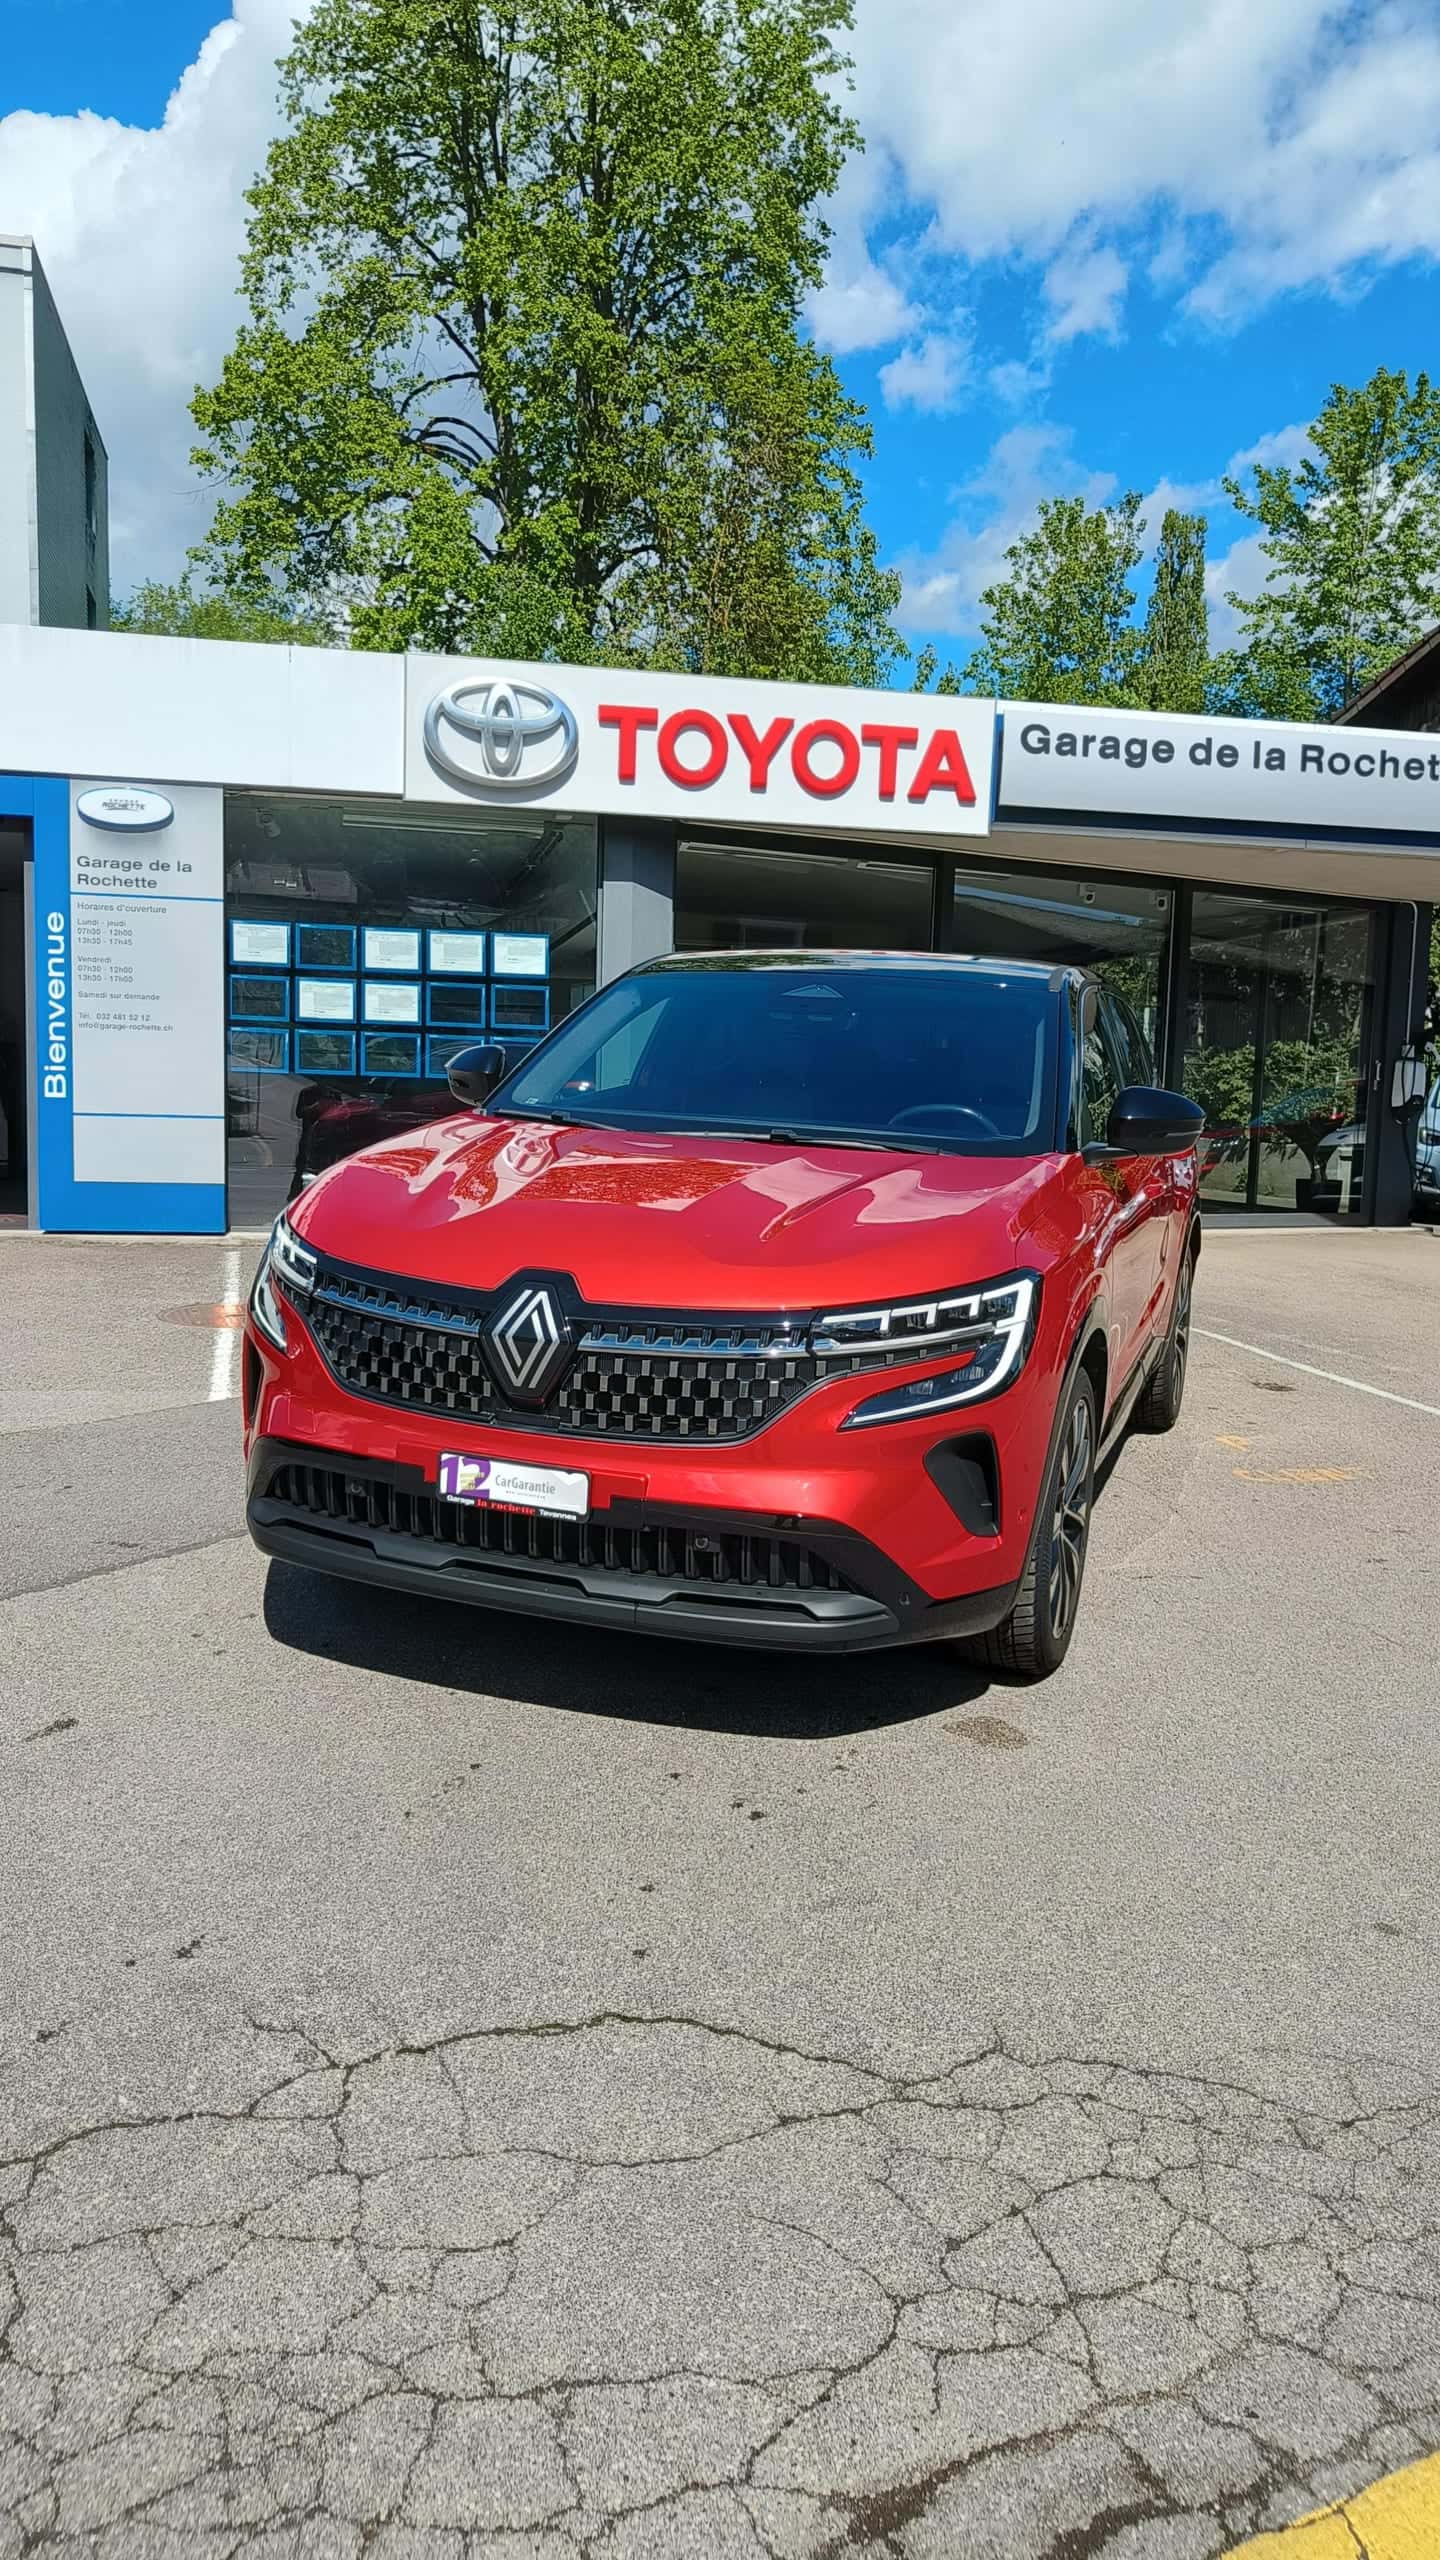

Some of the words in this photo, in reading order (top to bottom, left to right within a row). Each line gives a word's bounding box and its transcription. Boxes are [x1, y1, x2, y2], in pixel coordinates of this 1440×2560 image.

[598, 704, 976, 806] TOYOTA
[1020, 723, 1175, 768] Garage
[1189, 737, 1239, 768] de
[1253, 740, 1286, 771] la
[1300, 743, 1440, 782] Rochet
[77, 856, 143, 872] Garage
[149, 860, 171, 872] de
[177, 860, 192, 873] la
[77, 874, 158, 889] Rochette
[77, 902, 114, 912] Horaires
[116, 904, 167, 914] d'ouverture
[77, 918, 99, 926] Lundi
[77, 955, 112, 964] Vendredi
[78, 990, 107, 999] Samedi
[124, 992, 160, 1000] demande
[43, 911, 67, 1098] Bienvenue
[440, 1456, 491, 1499] 12
[495, 1474, 556, 1495] CarGarantie
